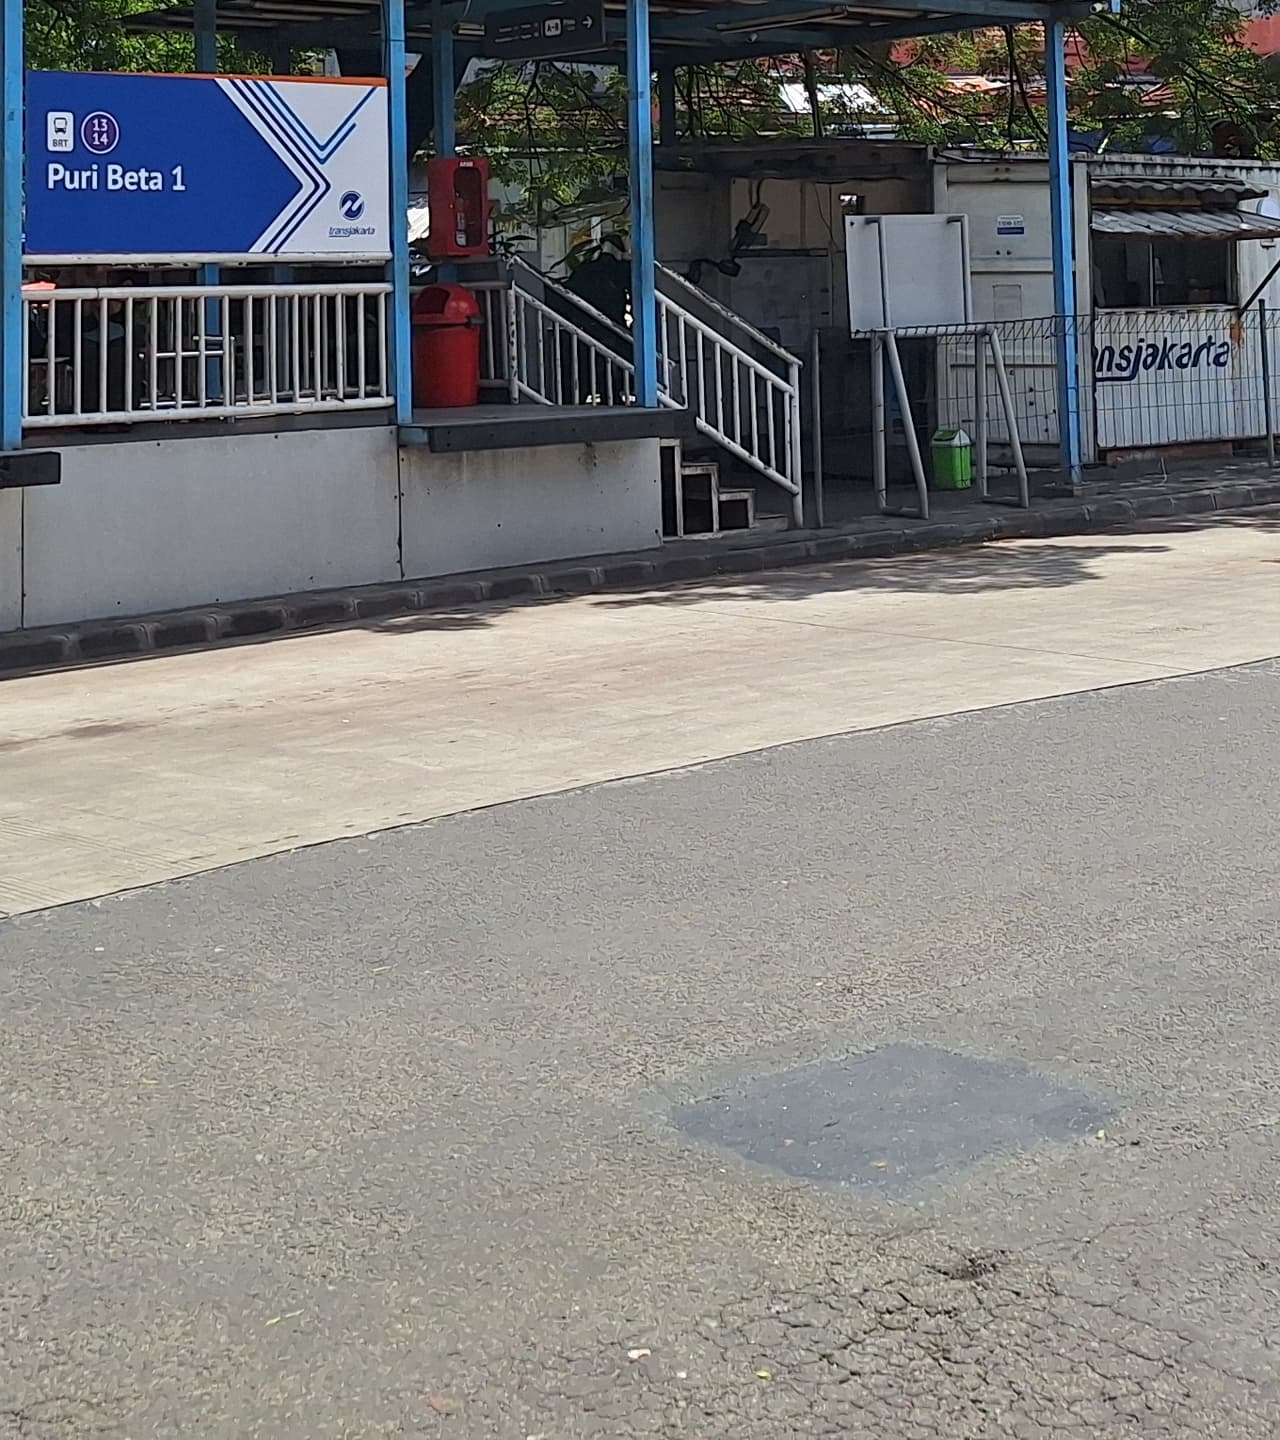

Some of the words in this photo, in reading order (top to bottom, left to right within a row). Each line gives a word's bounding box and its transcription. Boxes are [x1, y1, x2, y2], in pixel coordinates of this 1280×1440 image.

[92, 118, 109, 132] 13
[52, 139, 69, 148] BRT
[92, 132, 109, 146] 14
[47, 162, 99, 190] Puri
[106, 163, 163, 191] Beta
[171, 165, 186, 191] 1
[328, 226, 376, 238] transjakarta
[1093, 334, 1230, 382] nsjakarta
